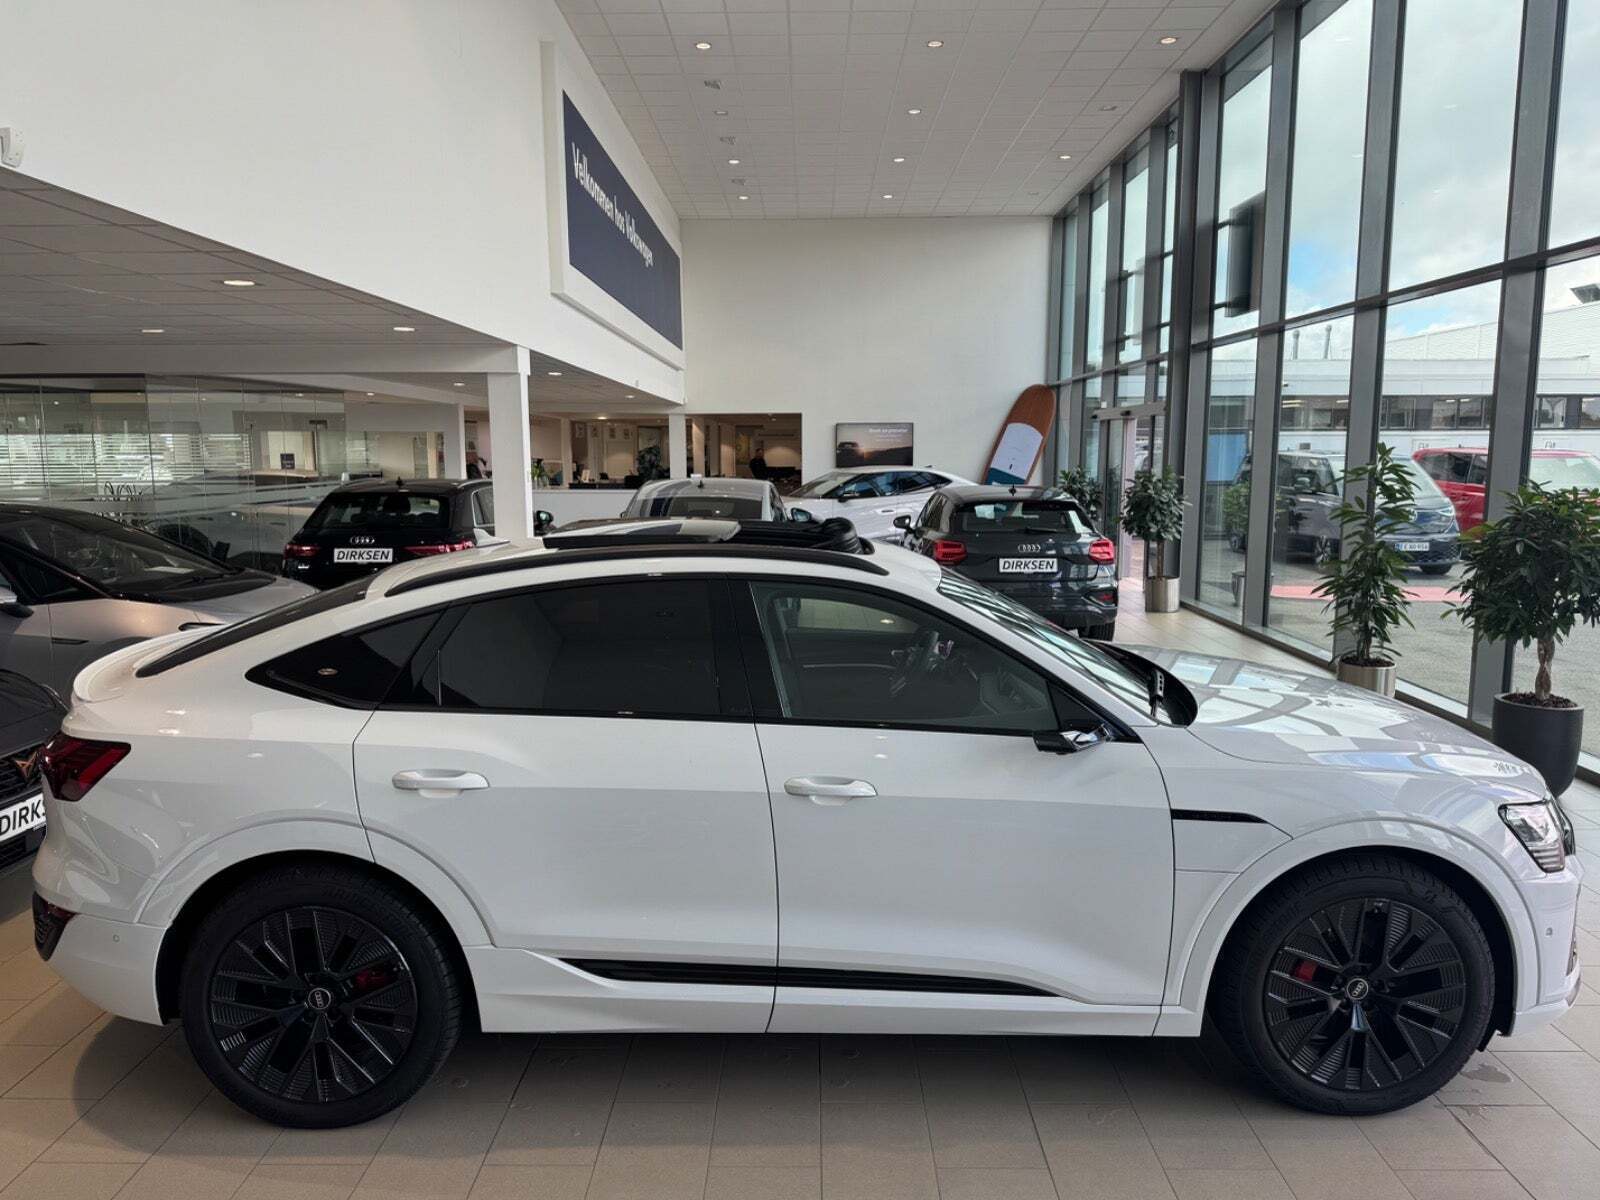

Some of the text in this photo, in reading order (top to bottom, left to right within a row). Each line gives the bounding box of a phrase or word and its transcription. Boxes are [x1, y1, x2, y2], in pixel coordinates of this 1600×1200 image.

[571, 141, 615, 222] Velkommen
[614, 195, 625, 234] hos
[337, 550, 390, 560] DIRKSEN
[1002, 560, 1055, 570] DIRKSEN
[0, 800, 46, 835] DIRK
